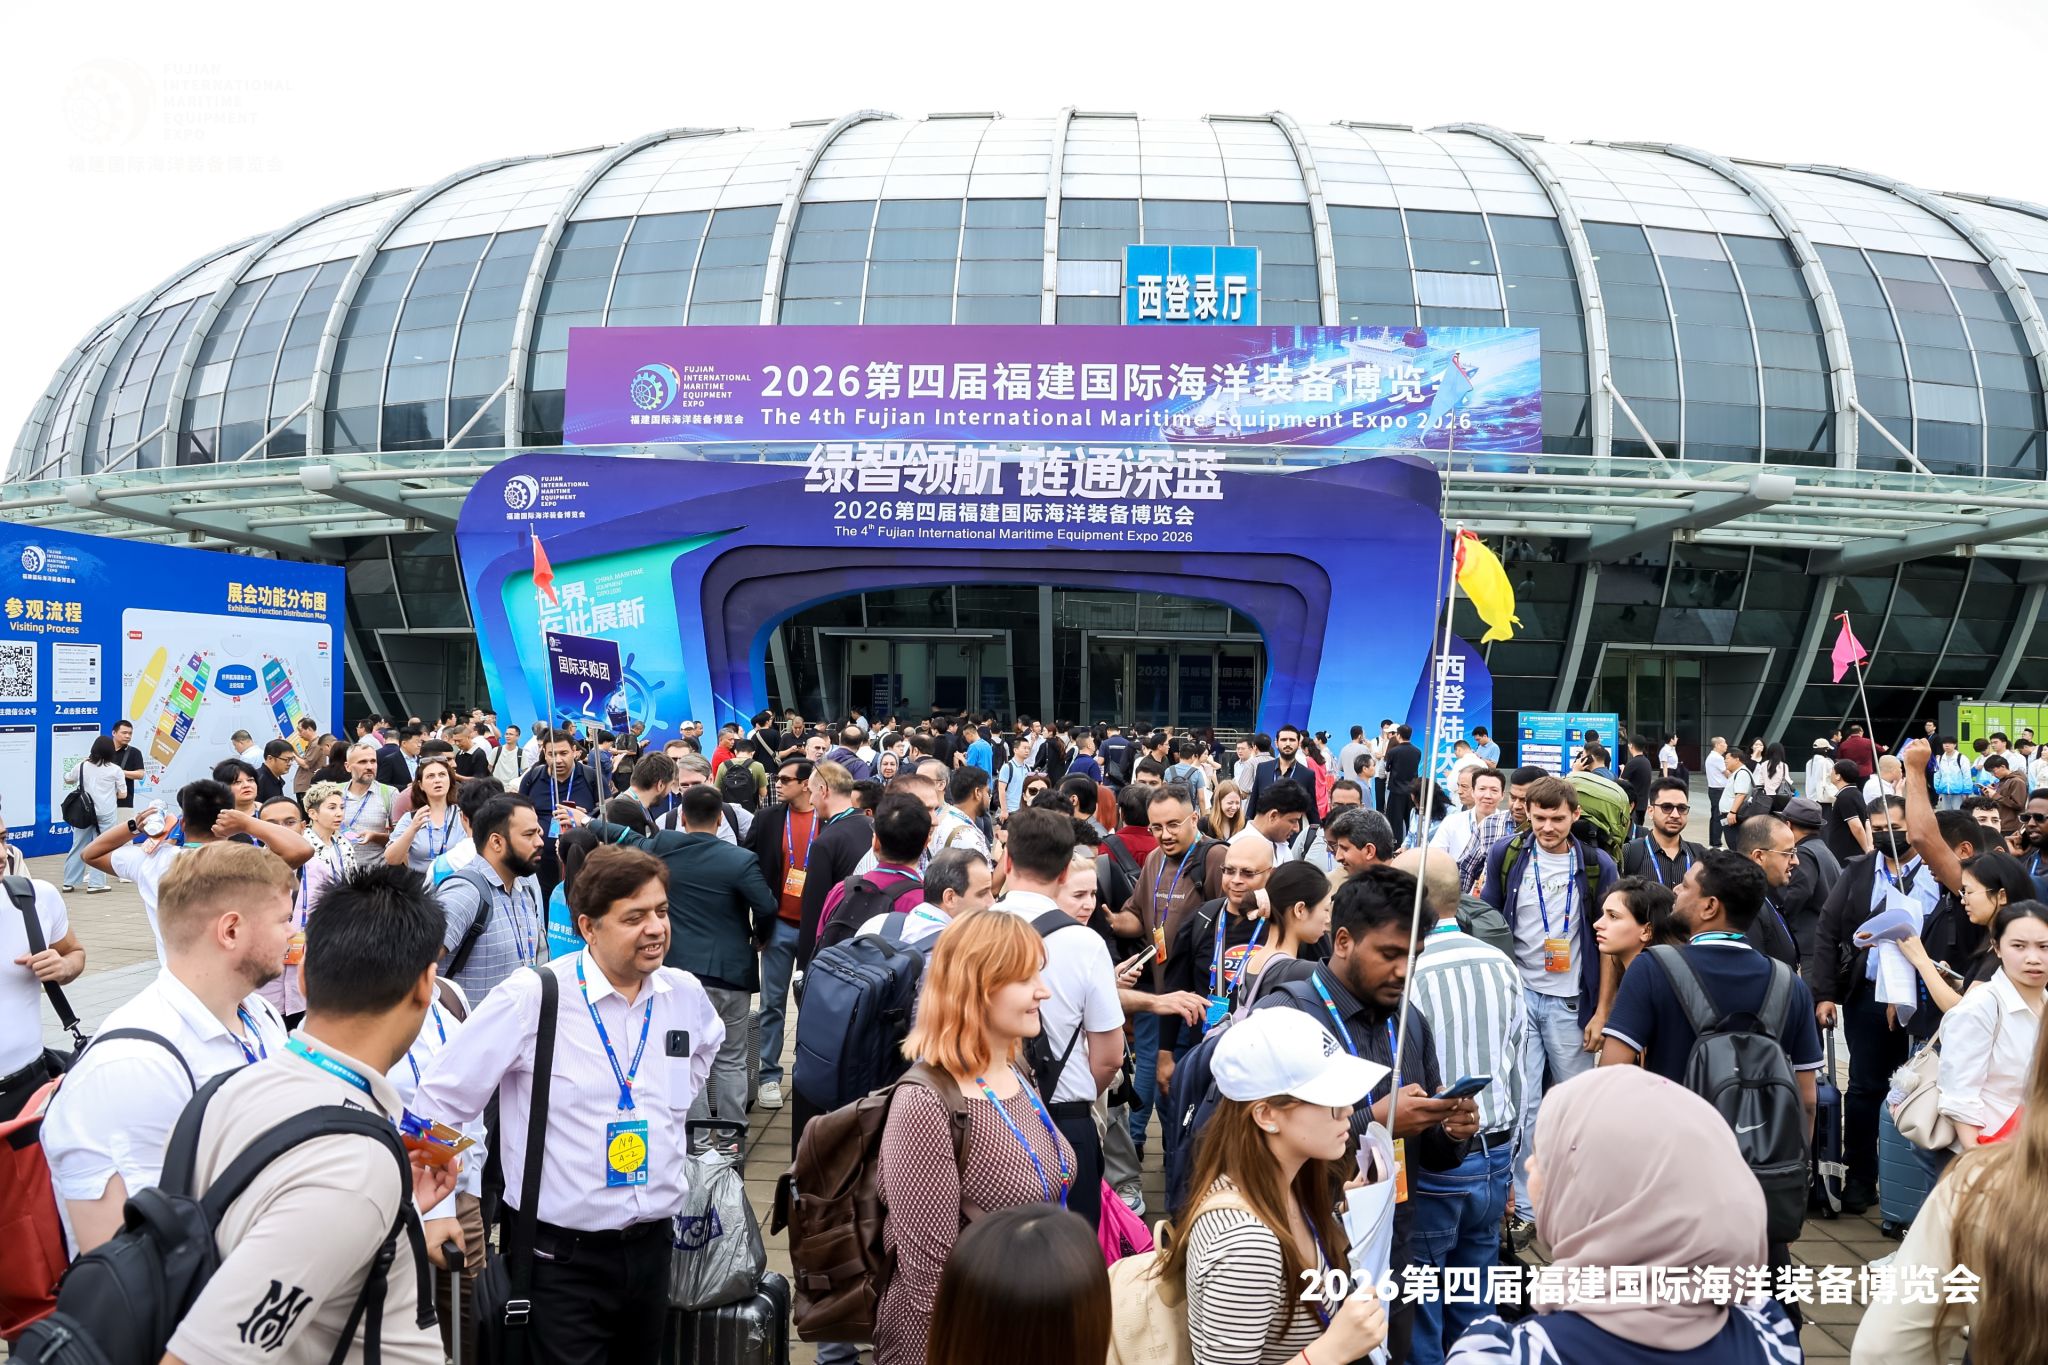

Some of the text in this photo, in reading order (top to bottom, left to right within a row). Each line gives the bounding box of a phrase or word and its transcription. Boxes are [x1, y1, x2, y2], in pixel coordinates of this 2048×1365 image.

[1137, 274, 1247, 320] 西登录厅
[684, 365, 714, 373] FUJIAN
[683, 382, 725, 390] MARITIME
[682, 391, 733, 399] EQUIPMENT
[682, 400, 705, 408] EXPO
[630, 414, 744, 425] 福建国际海洋装备博览会
[761, 408, 801, 425] The
[808, 407, 846, 425] 4th
[854, 407, 926, 429] Fujian
[935, 407, 1092, 426] International
[1101, 408, 1206, 427] Maritime
[1215, 410, 1344, 431] Equipment
[1352, 411, 1409, 432] Expo
[804, 442, 1226, 500] 绿智领航 链通深蓝
[833, 500, 1195, 526] 2026第四届福建国际海洋装备博览会
[834, 526, 857, 536] The
[878, 526, 915, 539] Fujian
[918, 527, 996, 539] International
[999, 528, 1054, 540] Maritime
[1057, 529, 1124, 541] Equipment
[1127, 531, 1159, 543] Expo
[1162, 531, 1193, 542] 2026
[614, 568, 645, 579] MARITIME
[228, 582, 327, 611] 展会功能分布图
[5, 597, 82, 623] 参观流程
[228, 604, 327, 620] Exhibition Function Distribution Map
[9, 621, 80, 634] Visiting Process
[558, 655, 610, 681] 国际采购团
[580, 681, 596, 718] 2
